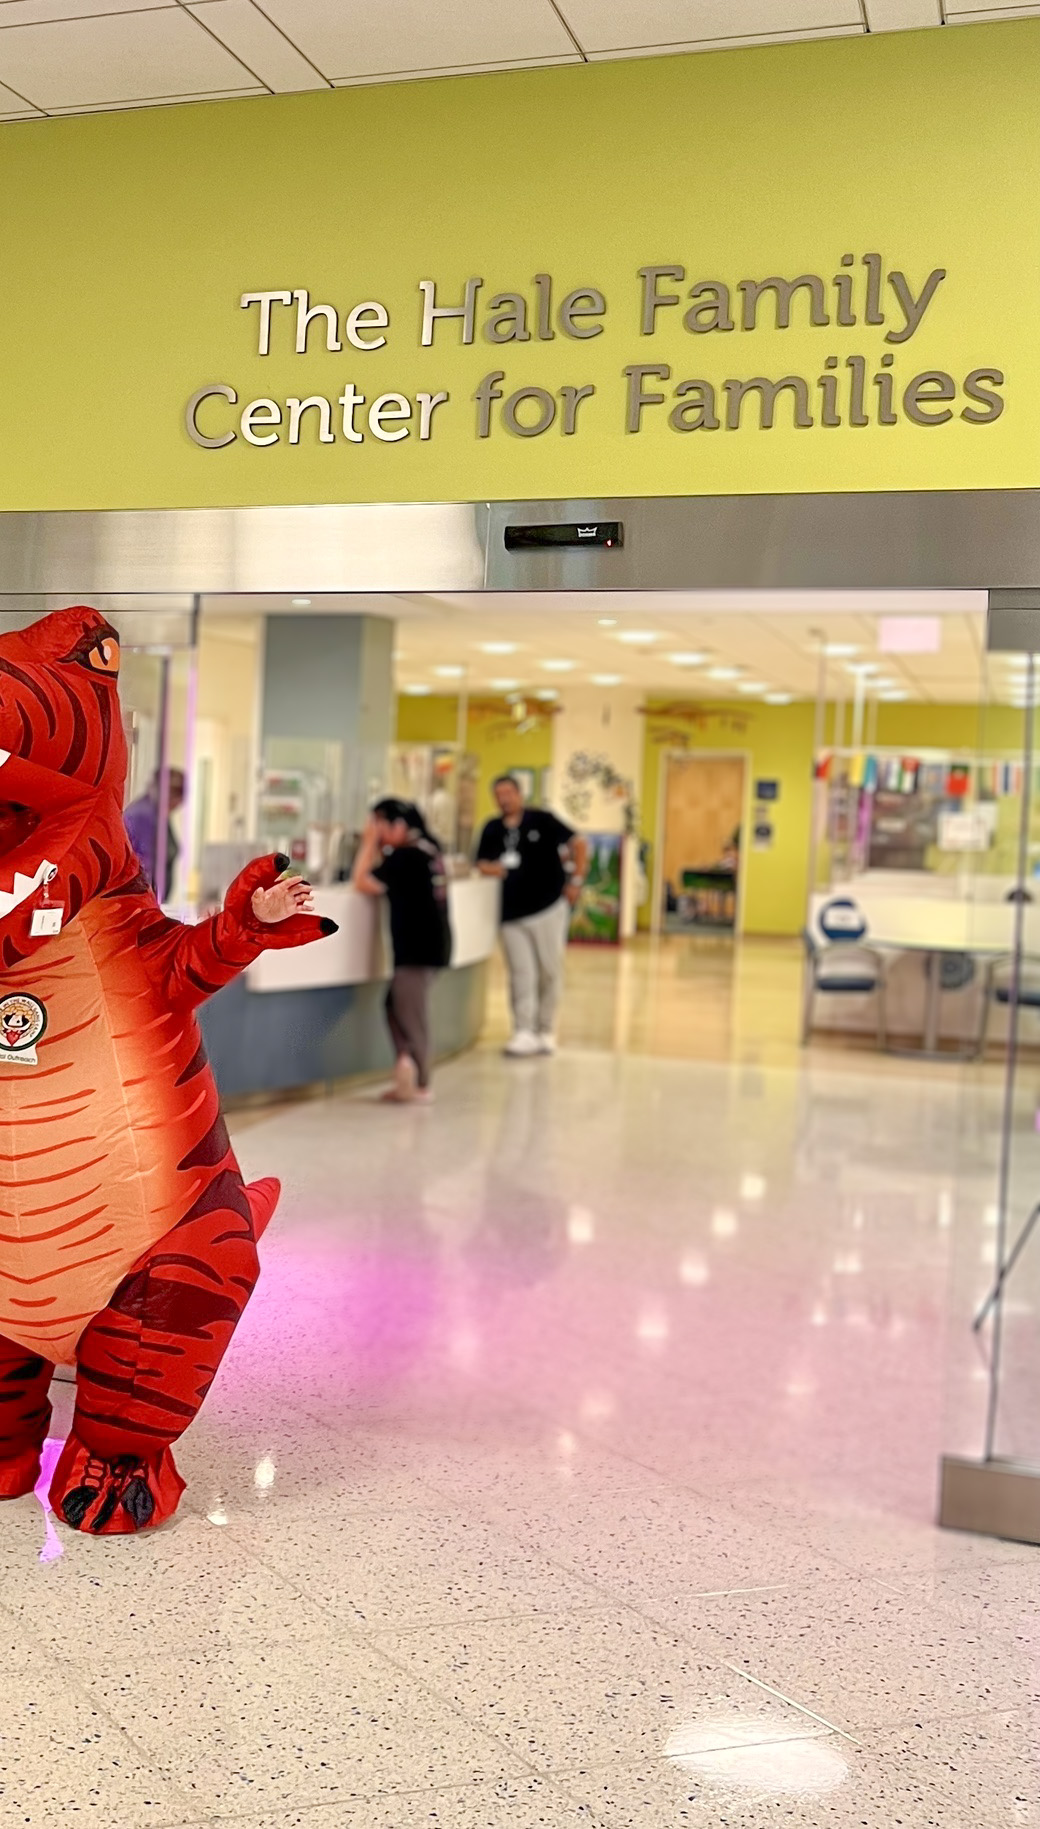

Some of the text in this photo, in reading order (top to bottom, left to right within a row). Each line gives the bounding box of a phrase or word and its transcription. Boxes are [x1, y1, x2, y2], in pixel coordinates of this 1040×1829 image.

[240, 252, 945, 356] The Hale Family
[184, 354, 1005, 449] Center for Families
